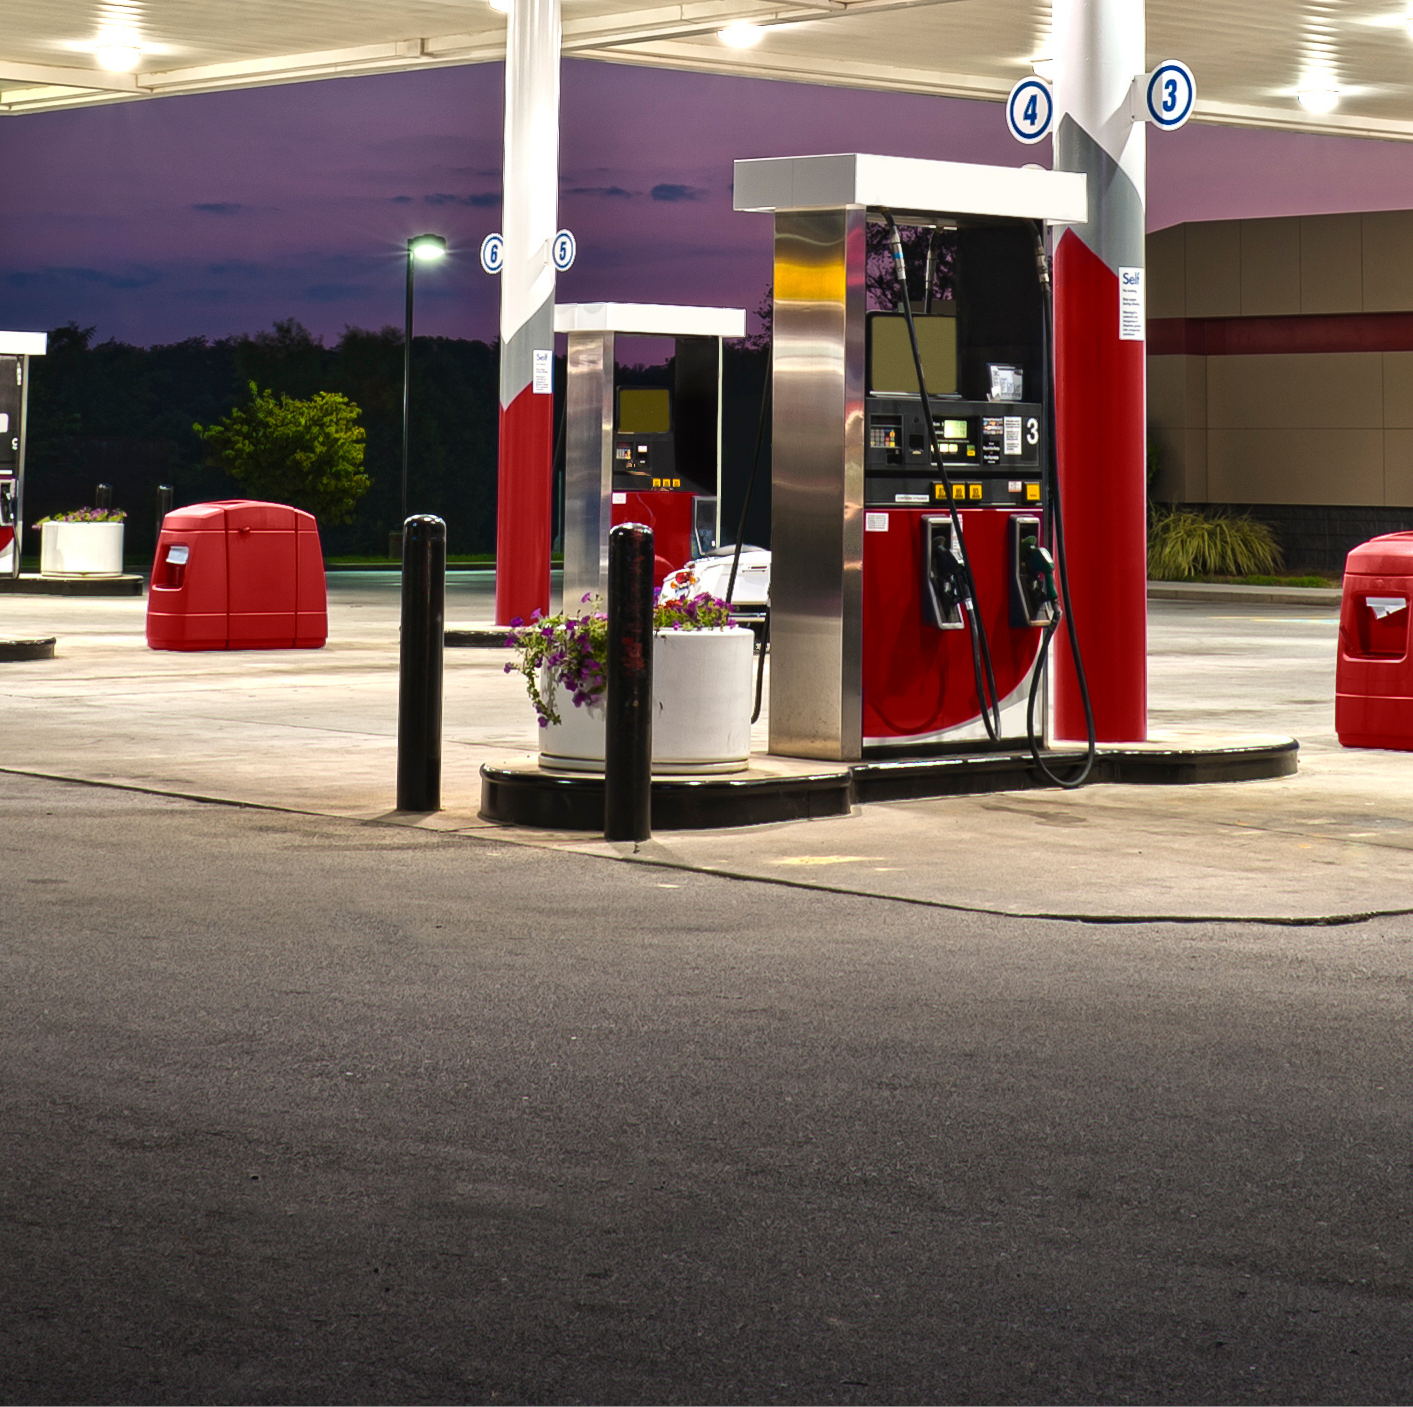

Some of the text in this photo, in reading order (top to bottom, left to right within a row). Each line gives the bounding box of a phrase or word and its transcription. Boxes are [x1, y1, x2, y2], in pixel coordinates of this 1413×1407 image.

[1162, 79, 1178, 112] 3
[1023, 94, 1038, 126] 4
[490, 244, 498, 263] 6
[559, 241, 567, 261] 5
[1122, 272, 1140, 285] Self
[1026, 417, 1039, 445] 3
